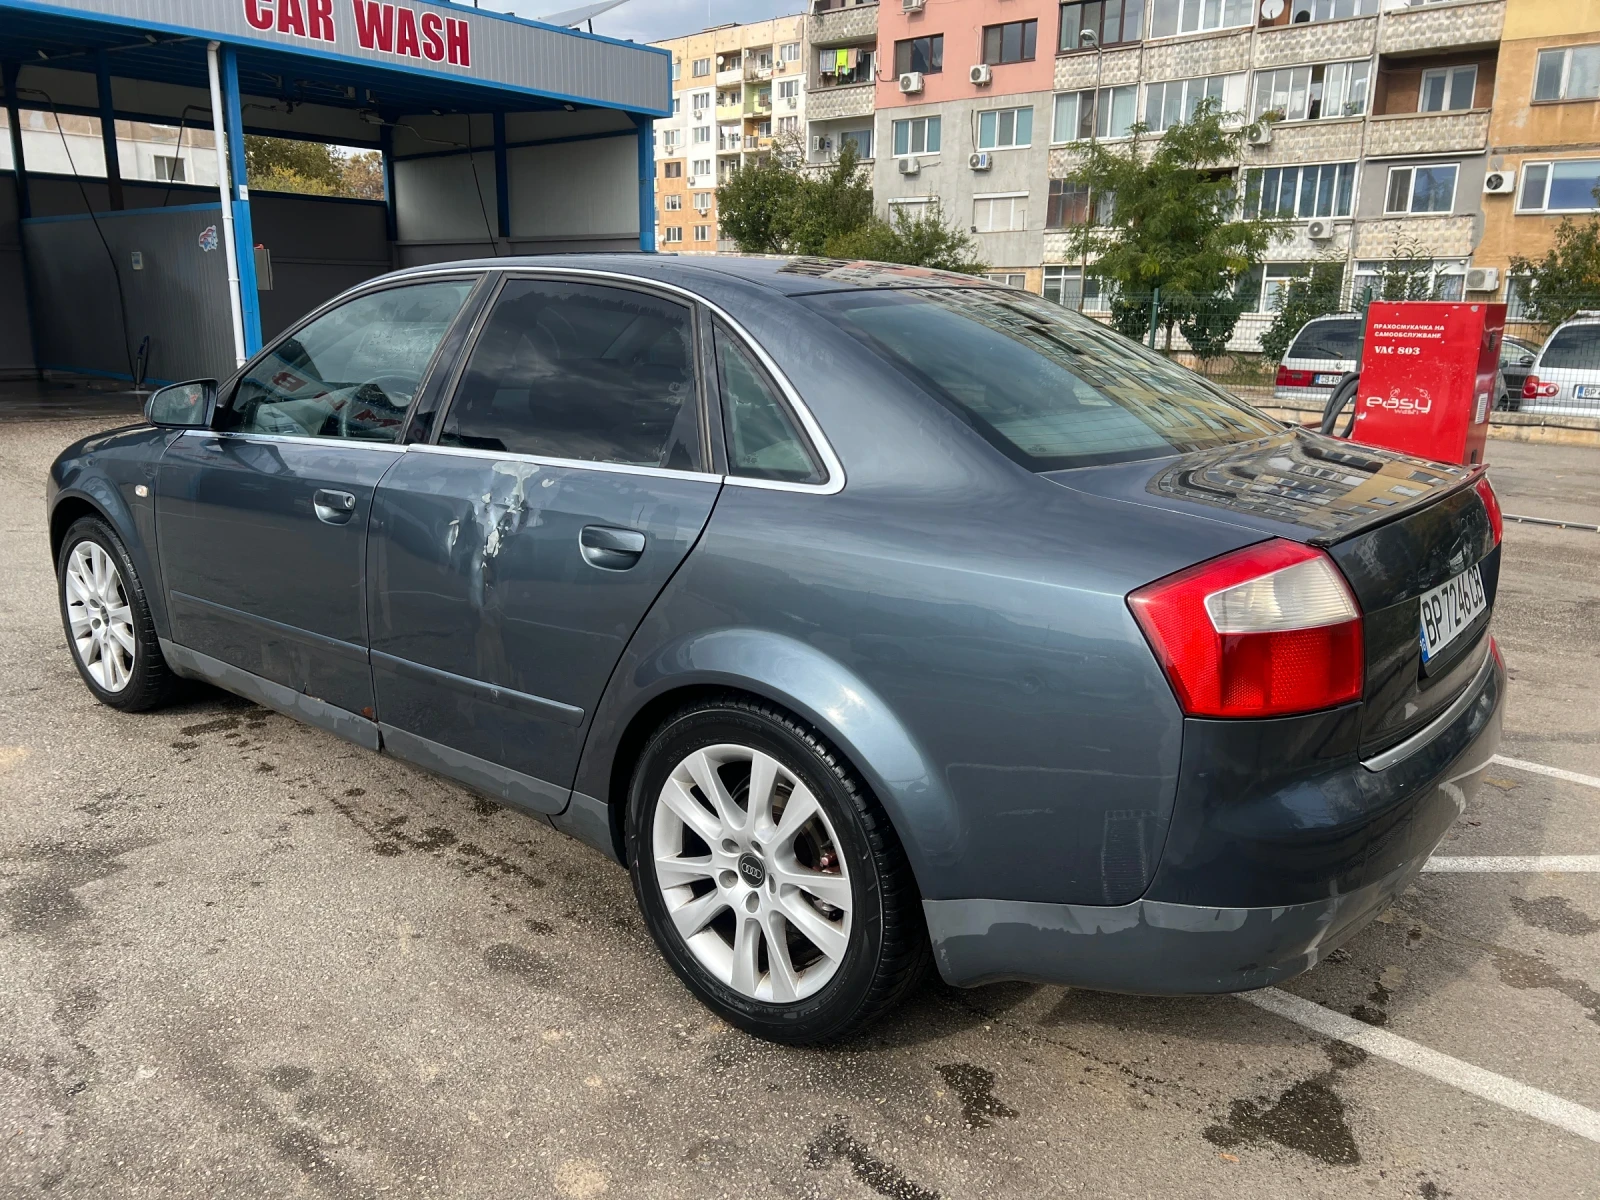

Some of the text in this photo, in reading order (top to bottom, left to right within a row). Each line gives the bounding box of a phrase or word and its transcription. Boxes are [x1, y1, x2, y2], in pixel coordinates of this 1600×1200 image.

[244, 0, 471, 68] CAR WASH
[1373, 323, 1433, 331] ПРАХОСМУКАЧКА
[1374, 345, 1420, 355] VAC 803
[1366, 396, 1432, 415] easy
